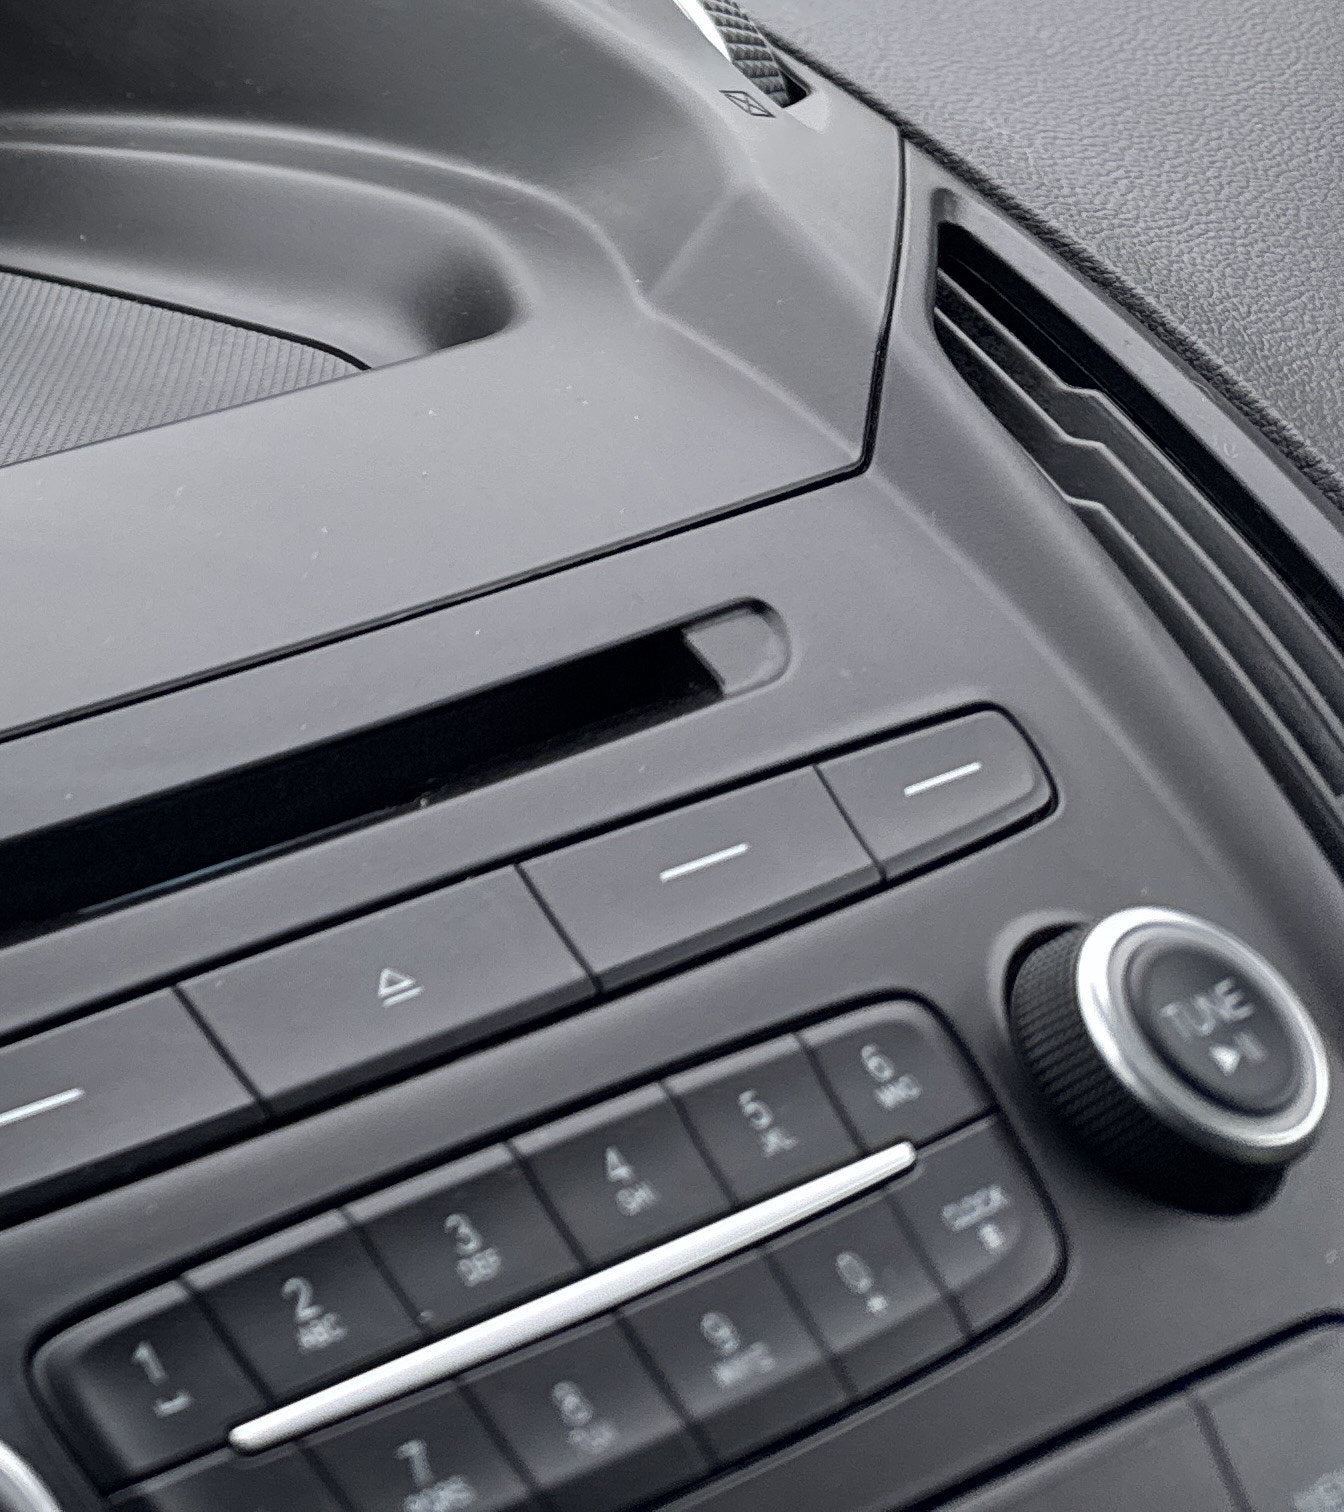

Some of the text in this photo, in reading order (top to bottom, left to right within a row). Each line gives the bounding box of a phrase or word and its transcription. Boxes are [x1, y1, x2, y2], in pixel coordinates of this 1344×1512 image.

[862, 1043, 894, 1081] 6
[738, 1089, 774, 1129] 5
[605, 1146, 633, 1181] 4
[445, 1214, 483, 1255] 3
[282, 1278, 324, 1322] 2
[133, 1340, 167, 1386] 1
